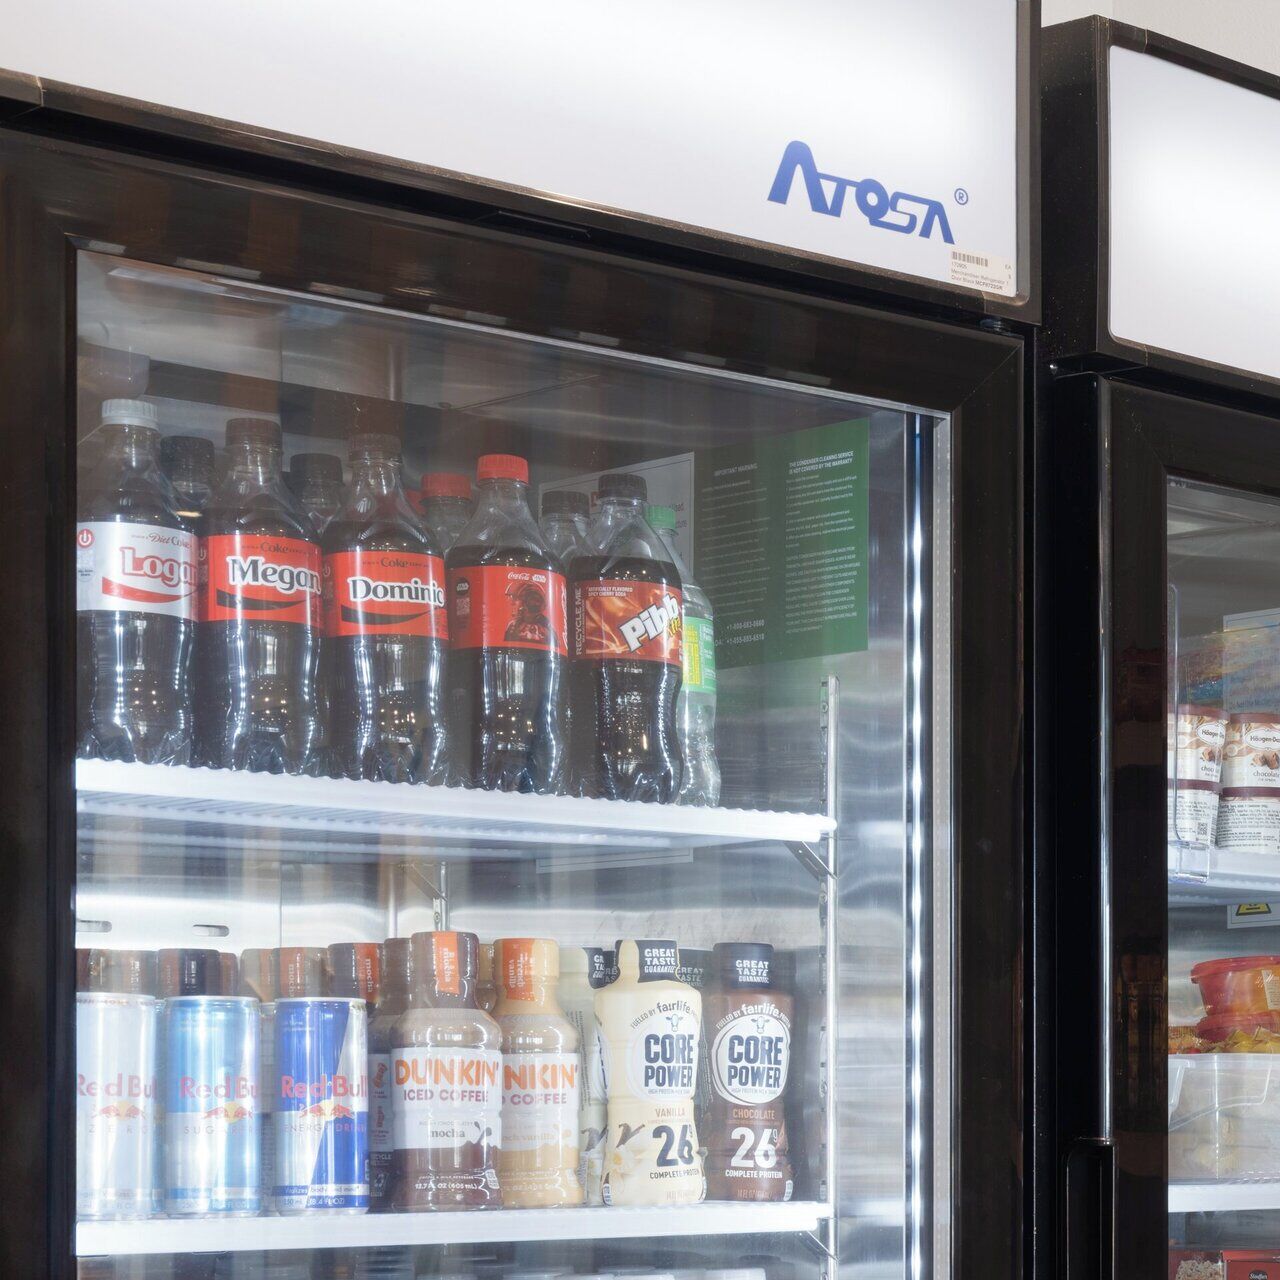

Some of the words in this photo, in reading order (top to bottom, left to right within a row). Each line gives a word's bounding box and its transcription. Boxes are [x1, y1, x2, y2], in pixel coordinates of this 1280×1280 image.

[226, 556, 321, 595] Megan
[348, 578, 445, 606] Dominic
[619, 593, 680, 653] Pibb
[1252, 769, 1280, 778] chocolate
[645, 949, 675, 958] GREAT
[645, 958, 676, 966] TASTE
[735, 960, 769, 969] GREAT
[737, 968, 769, 977] TASTE
[644, 1033, 694, 1064] CORE
[728, 1034, 784, 1065] CORE
[644, 1065, 693, 1088] POWER
[727, 1064, 781, 1088] POWER
[180, 1076, 232, 1099] Red
[281, 1074, 328, 1098] Red
[403, 1089, 434, 1101] ICED
[439, 1090, 489, 1102] COFFEE
[510, 1092, 568, 1107] COFFEE
[655, 1107, 687, 1118] VANILLA
[732, 1108, 776, 1119] CHOCOLATE
[725, 1170, 755, 1178] COMPLETE
[757, 1170, 783, 1179] PROTEIN
